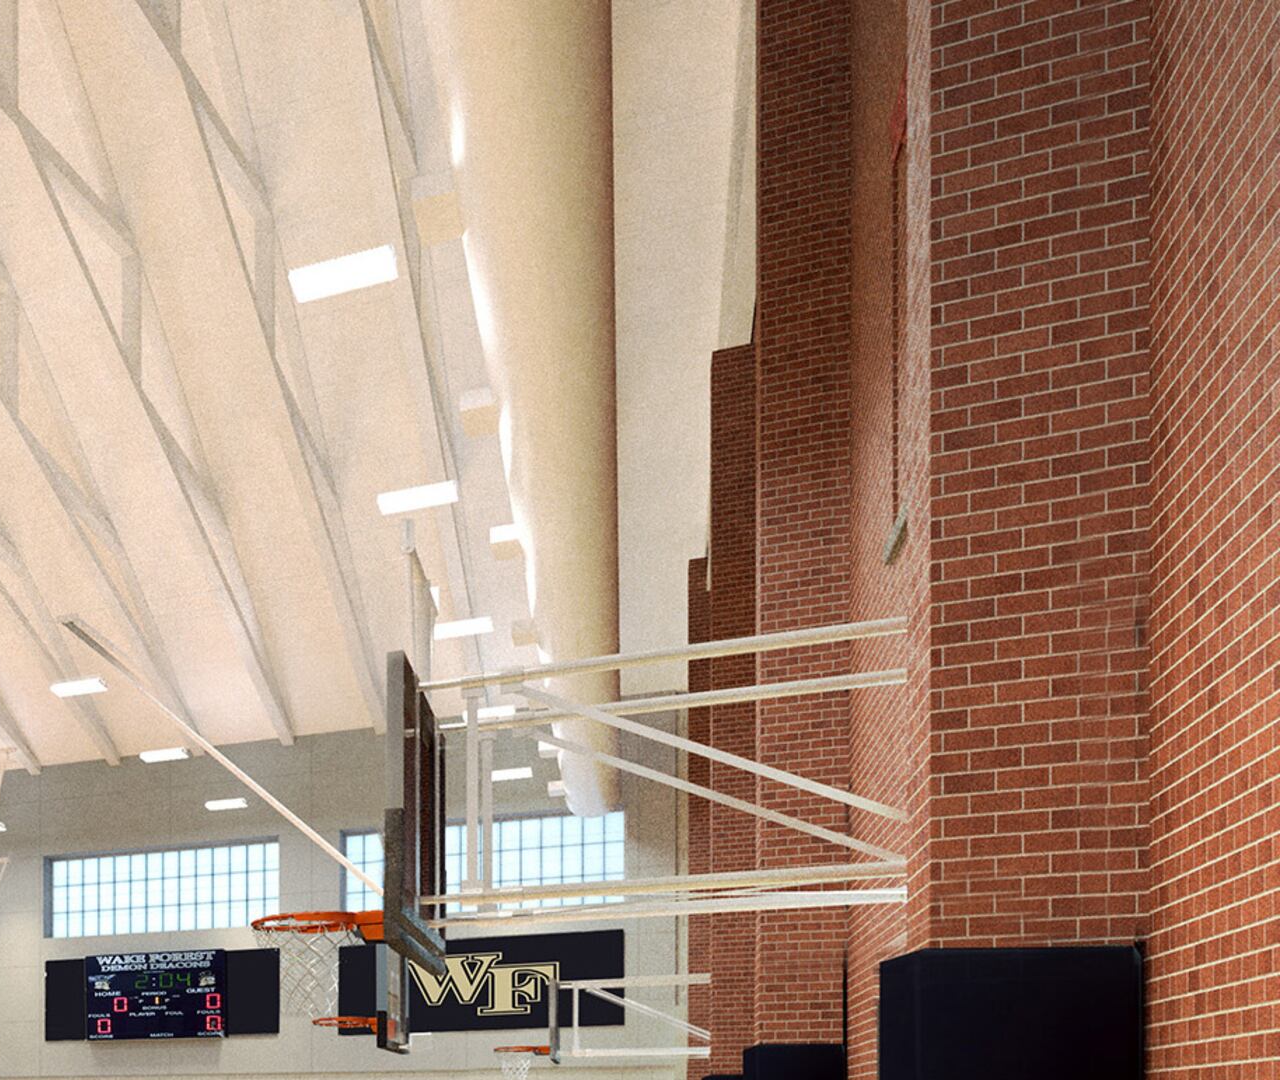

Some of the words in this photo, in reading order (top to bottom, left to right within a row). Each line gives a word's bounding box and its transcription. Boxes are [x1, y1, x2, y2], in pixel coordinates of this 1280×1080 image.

[96, 954, 146, 966] WAKE
[149, 951, 216, 963] FOREST
[101, 963, 148, 972] DEMON
[150, 960, 211, 970] DEACONS
[135, 973, 191, 989] 2:04
[407, 952, 560, 1016] WF
[113, 996, 128, 1012] 0
[206, 993, 220, 1009] 0
[97, 1018, 111, 1034] 0
